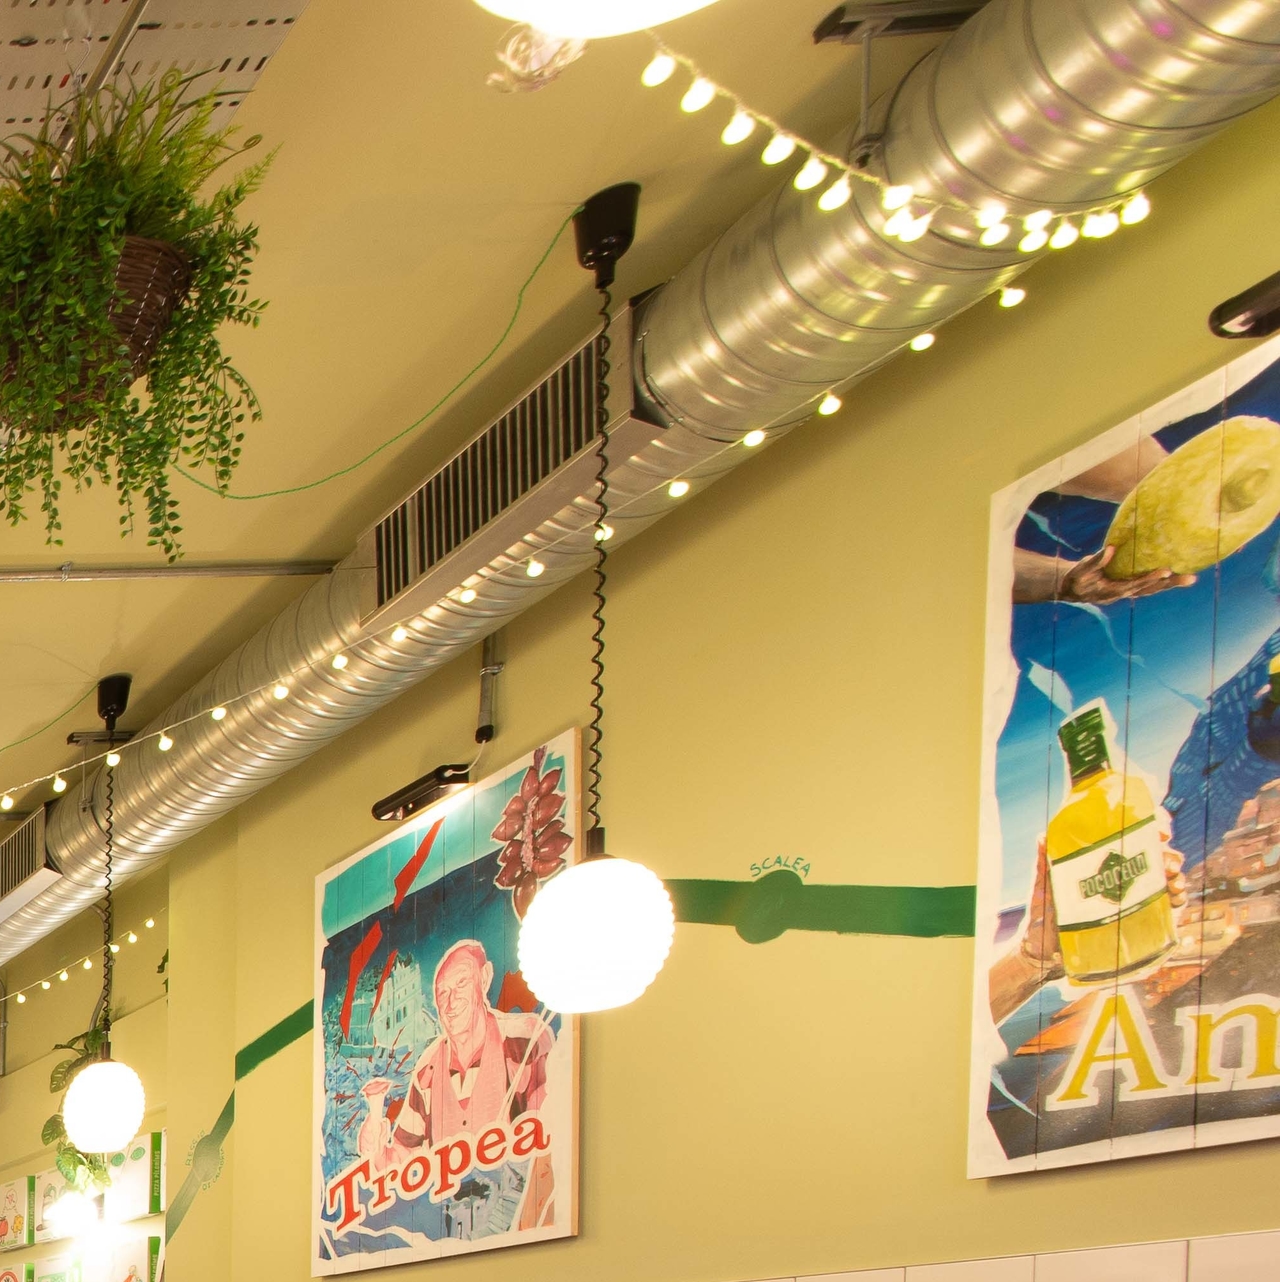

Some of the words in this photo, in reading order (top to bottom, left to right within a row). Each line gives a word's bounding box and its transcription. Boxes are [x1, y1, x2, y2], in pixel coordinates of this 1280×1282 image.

[749, 854, 811, 879] SCALEA
[1080, 852, 1147, 899] POCOCELLO
[184, 1129, 206, 1167] REGGIO
[327, 1110, 552, 1235] Tropea
